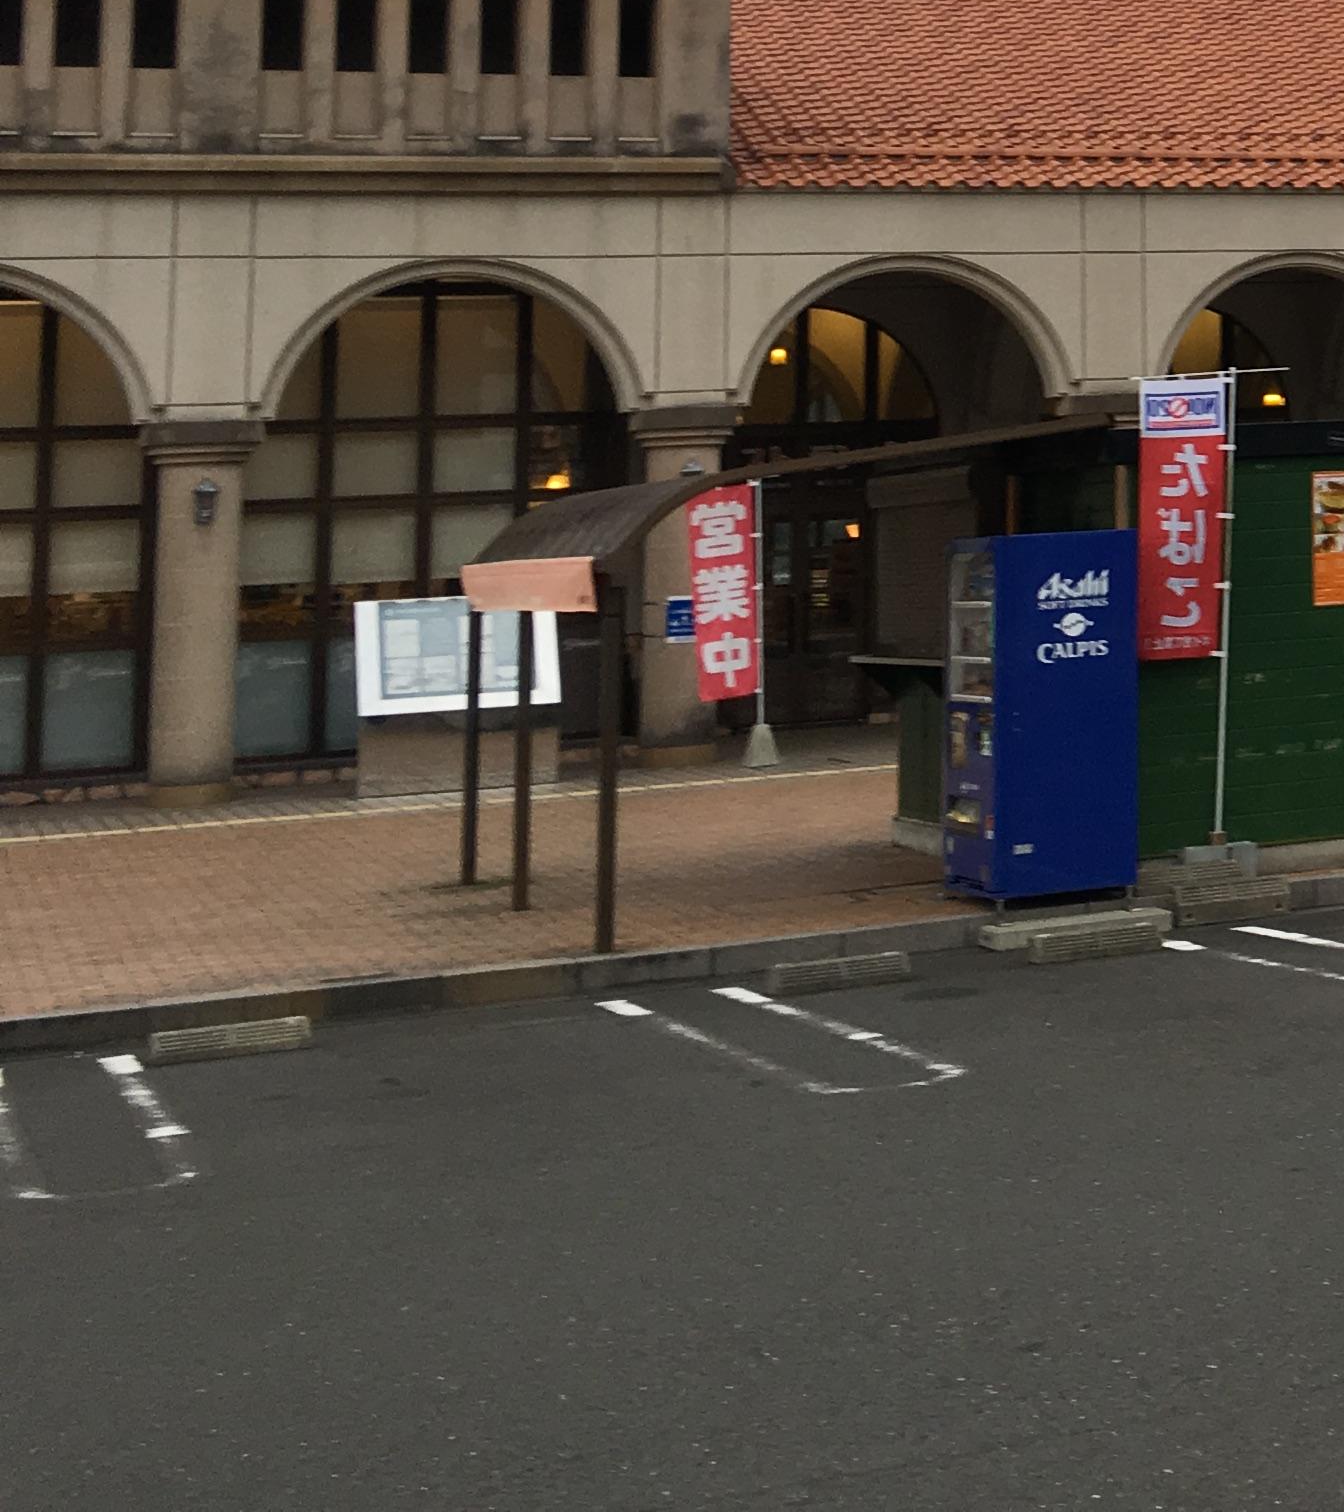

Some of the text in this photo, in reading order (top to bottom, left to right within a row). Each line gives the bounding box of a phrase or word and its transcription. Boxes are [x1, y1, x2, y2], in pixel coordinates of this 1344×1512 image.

[689, 500, 751, 688] 営業中
[1037, 569, 1110, 600] Asahi
[1036, 639, 1110, 664] CALPIS
